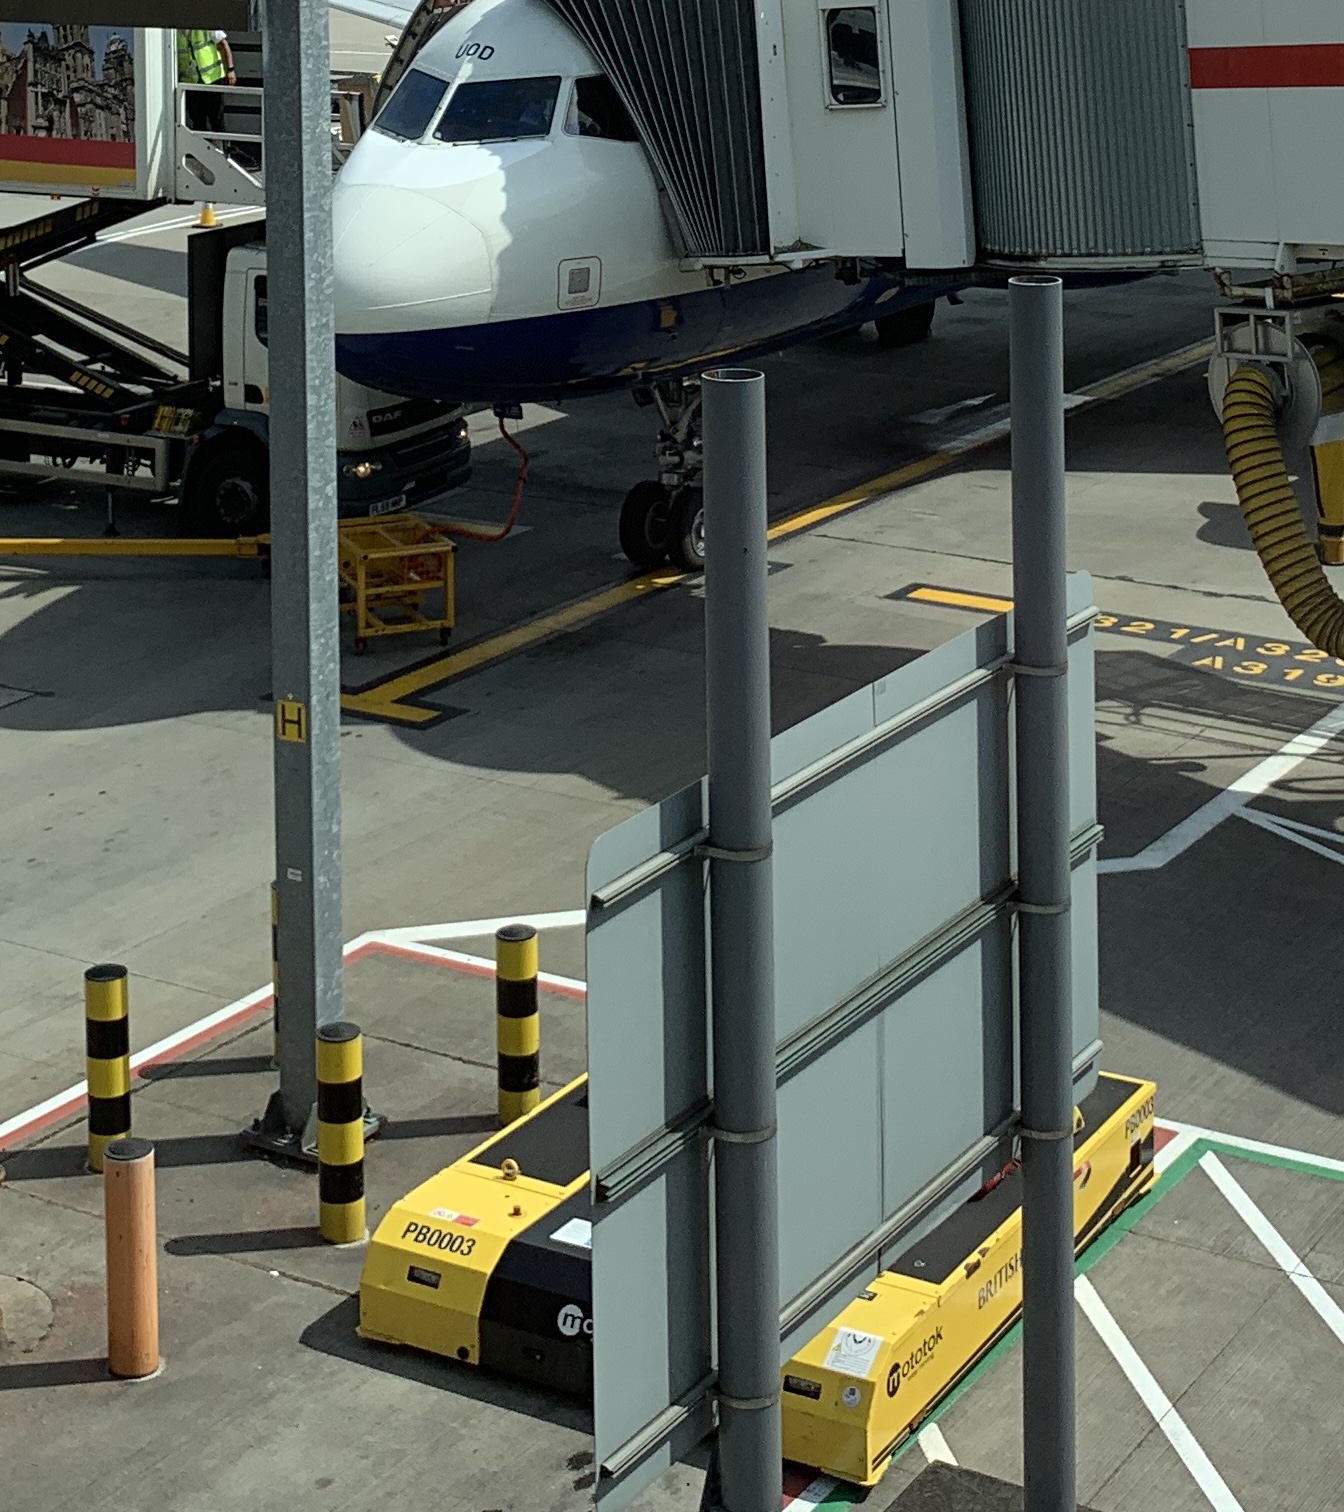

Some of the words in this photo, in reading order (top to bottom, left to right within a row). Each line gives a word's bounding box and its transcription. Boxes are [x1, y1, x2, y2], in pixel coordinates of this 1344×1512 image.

[371, 410, 402, 424] DAF
[281, 704, 302, 738] H
[401, 1221, 477, 1256] PB0003
